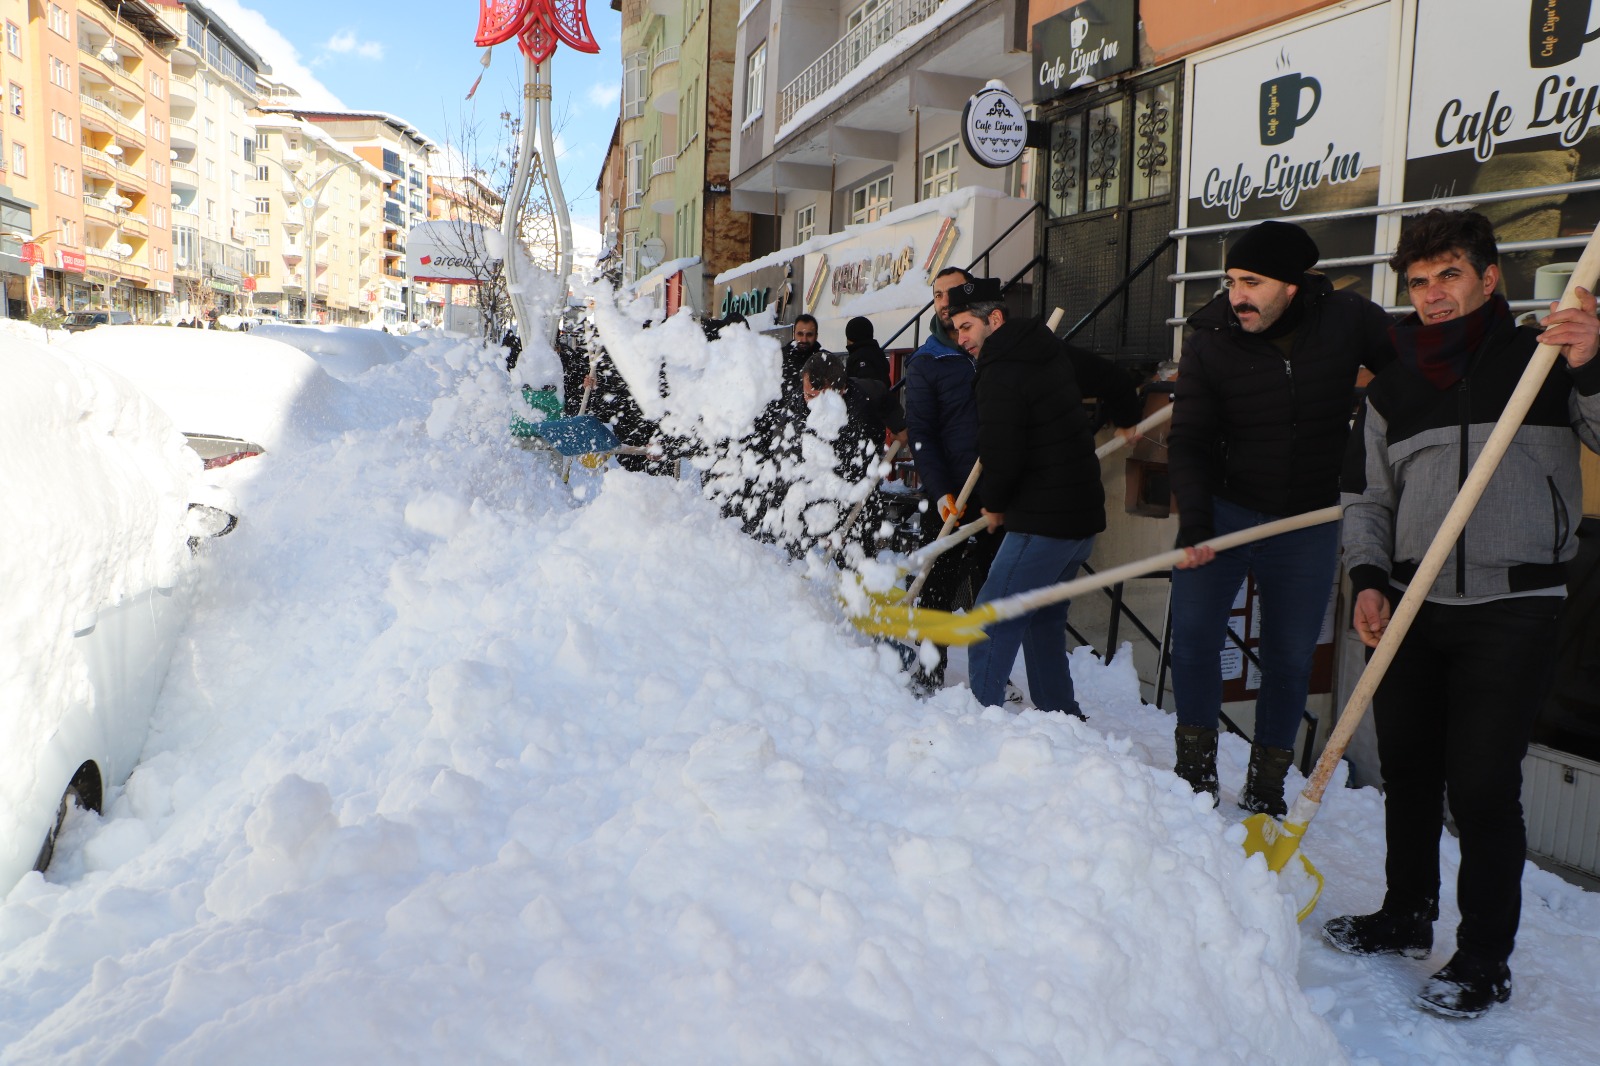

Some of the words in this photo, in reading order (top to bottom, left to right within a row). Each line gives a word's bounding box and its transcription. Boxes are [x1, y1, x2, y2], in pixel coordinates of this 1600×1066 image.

[1541, 35, 1559, 57] Cafe
[1039, 56, 1066, 90] Cafe
[1069, 38, 1119, 78] Liya'm
[1268, 84, 1281, 116] Liya'm
[975, 119, 992, 134] Cafe
[994, 121, 1023, 135] Liya'm
[1267, 118, 1280, 137] Cafe
[1434, 90, 1516, 159] Cafe
[1526, 74, 1600, 143] Liy
[1203, 162, 1253, 217] Cafe
[1259, 142, 1364, 207] Liya'm
